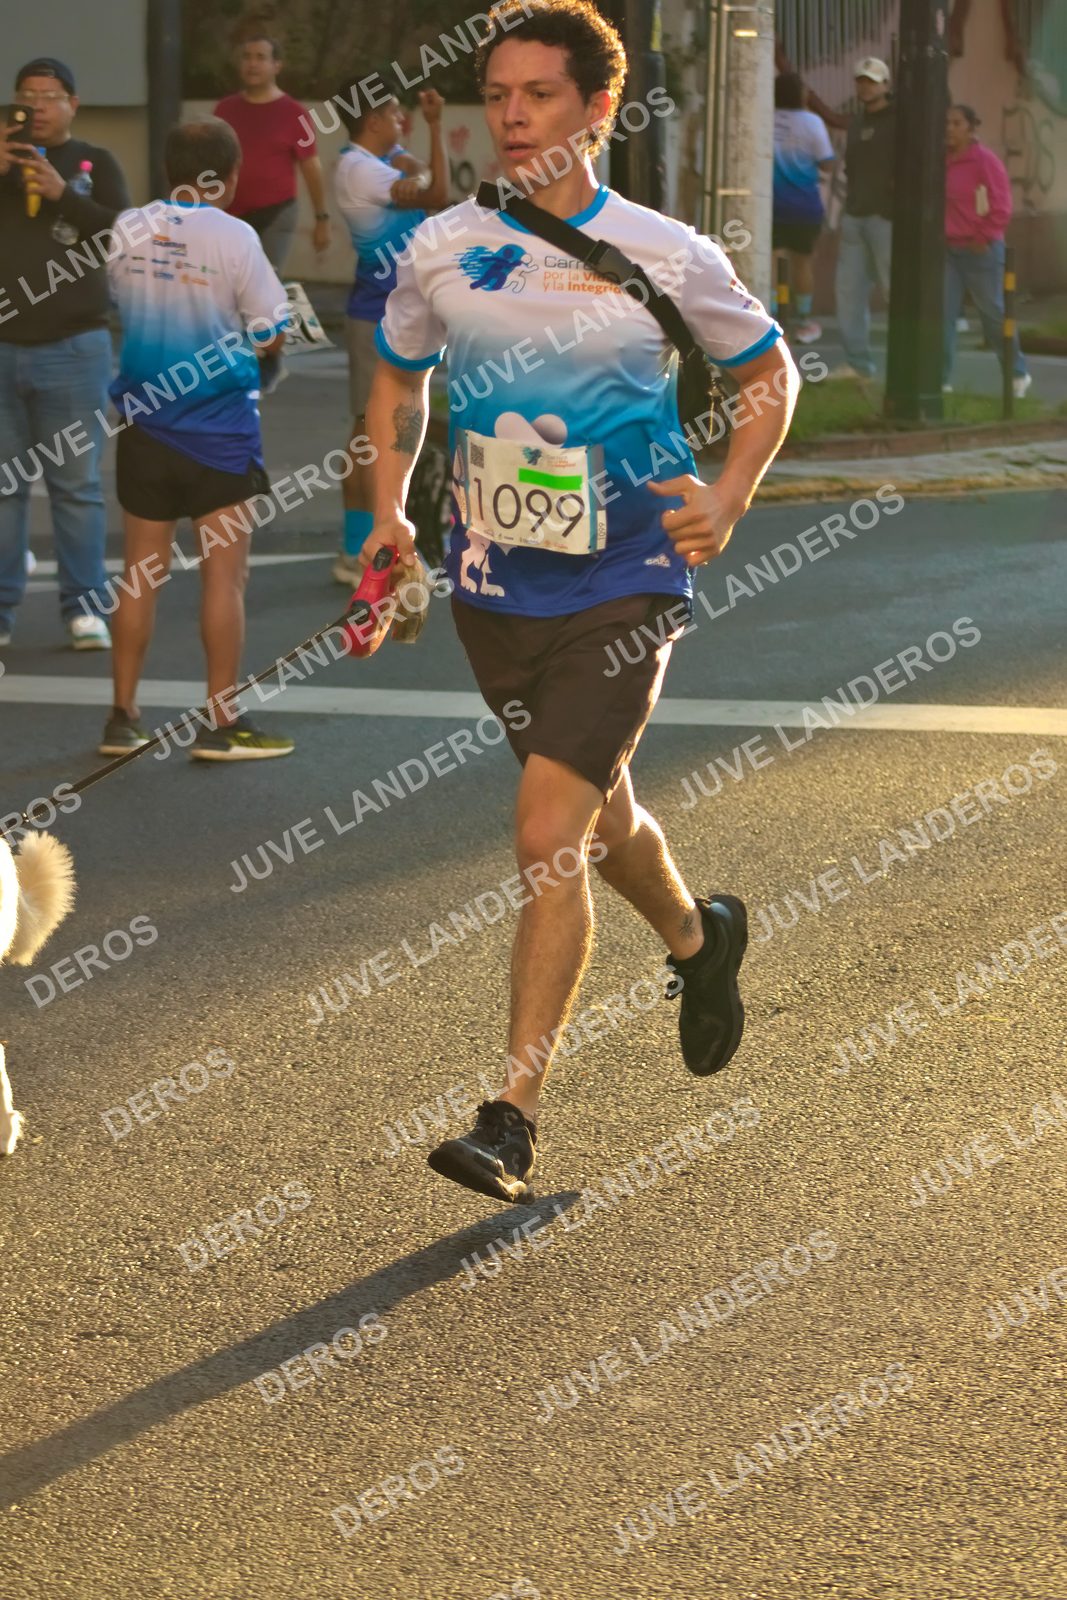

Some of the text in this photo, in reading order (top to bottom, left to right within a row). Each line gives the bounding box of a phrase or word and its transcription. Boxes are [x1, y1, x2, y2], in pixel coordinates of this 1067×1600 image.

[543, 272, 565, 283] por
[568, 271, 580, 282] la
[543, 283, 551, 294] y
[552, 281, 565, 292] la
[474, 477, 585, 538] 1099
[597, 522, 606, 541] 1099
